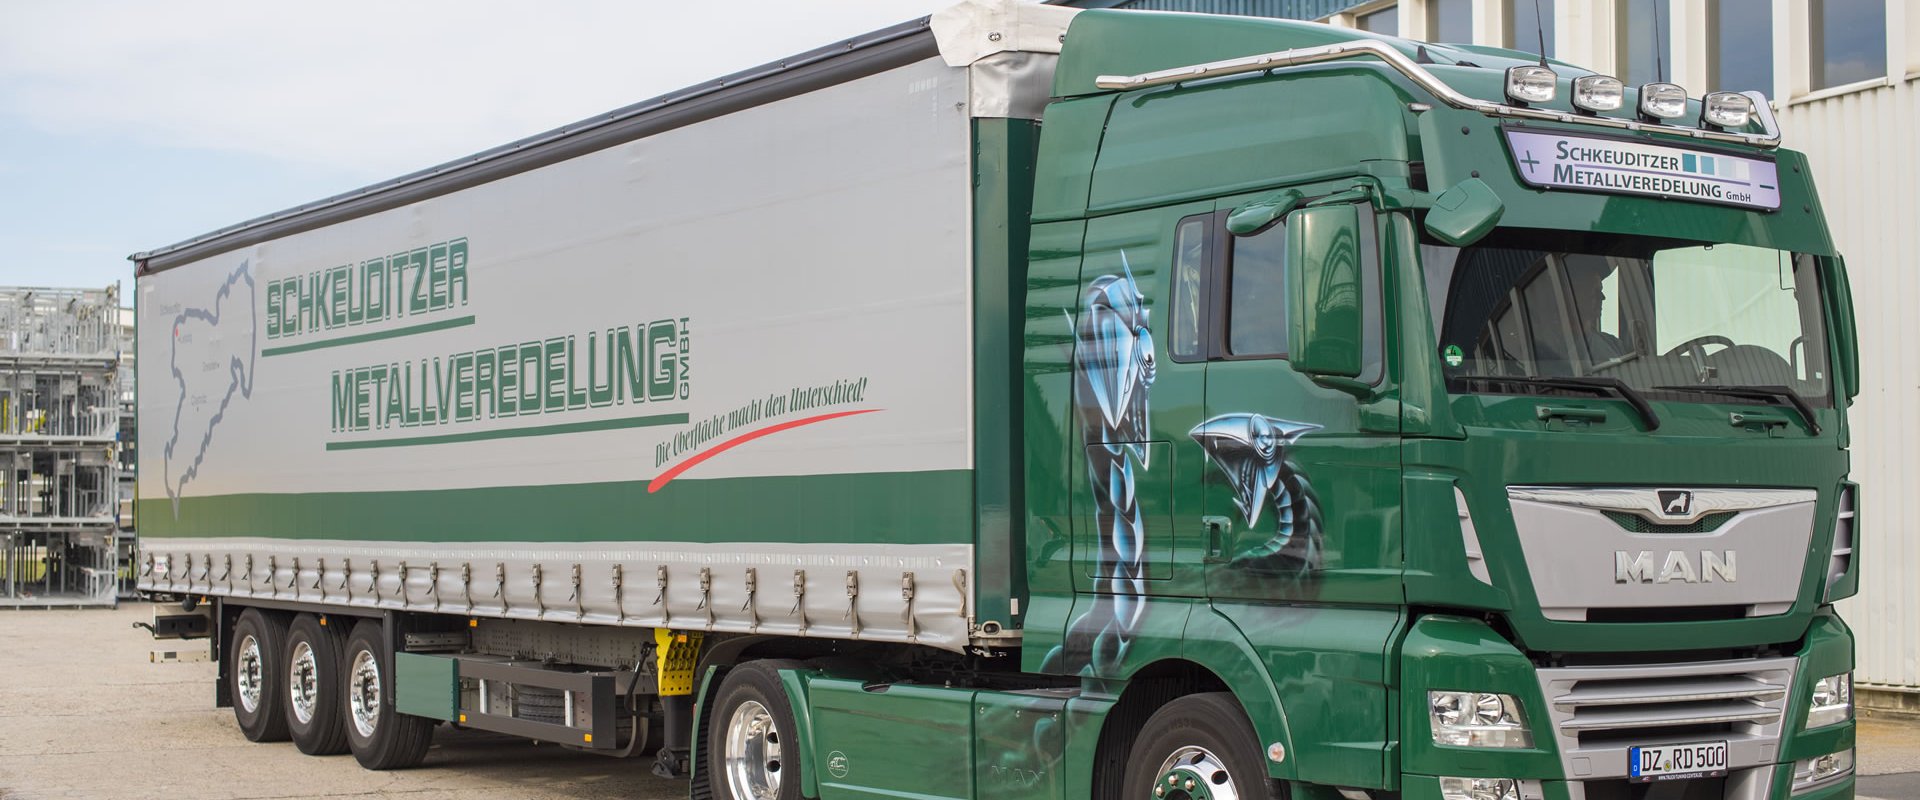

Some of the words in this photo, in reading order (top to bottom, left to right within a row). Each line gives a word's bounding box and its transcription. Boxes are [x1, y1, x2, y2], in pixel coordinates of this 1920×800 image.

[1553, 164, 1722, 197] METALLVEREDELUNG
[1725, 190, 1752, 203] GmbH
[1556, 141, 1679, 170] SCHKEUDITZER
[266, 238, 468, 339] SCHKEUDITZER
[331, 320, 676, 432] METALLVEREDELUNG
[679, 317, 689, 399] GMBH
[656, 442, 671, 468] Die
[673, 414, 725, 456] Oberfläche
[727, 399, 763, 430] macht
[765, 393, 786, 418] den
[790, 377, 867, 412] Unterschied!
[1615, 550, 1736, 584] MAN
[1642, 750, 1661, 771] DZ
[1673, 748, 1693, 769] RD
[1696, 746, 1724, 767] 500
